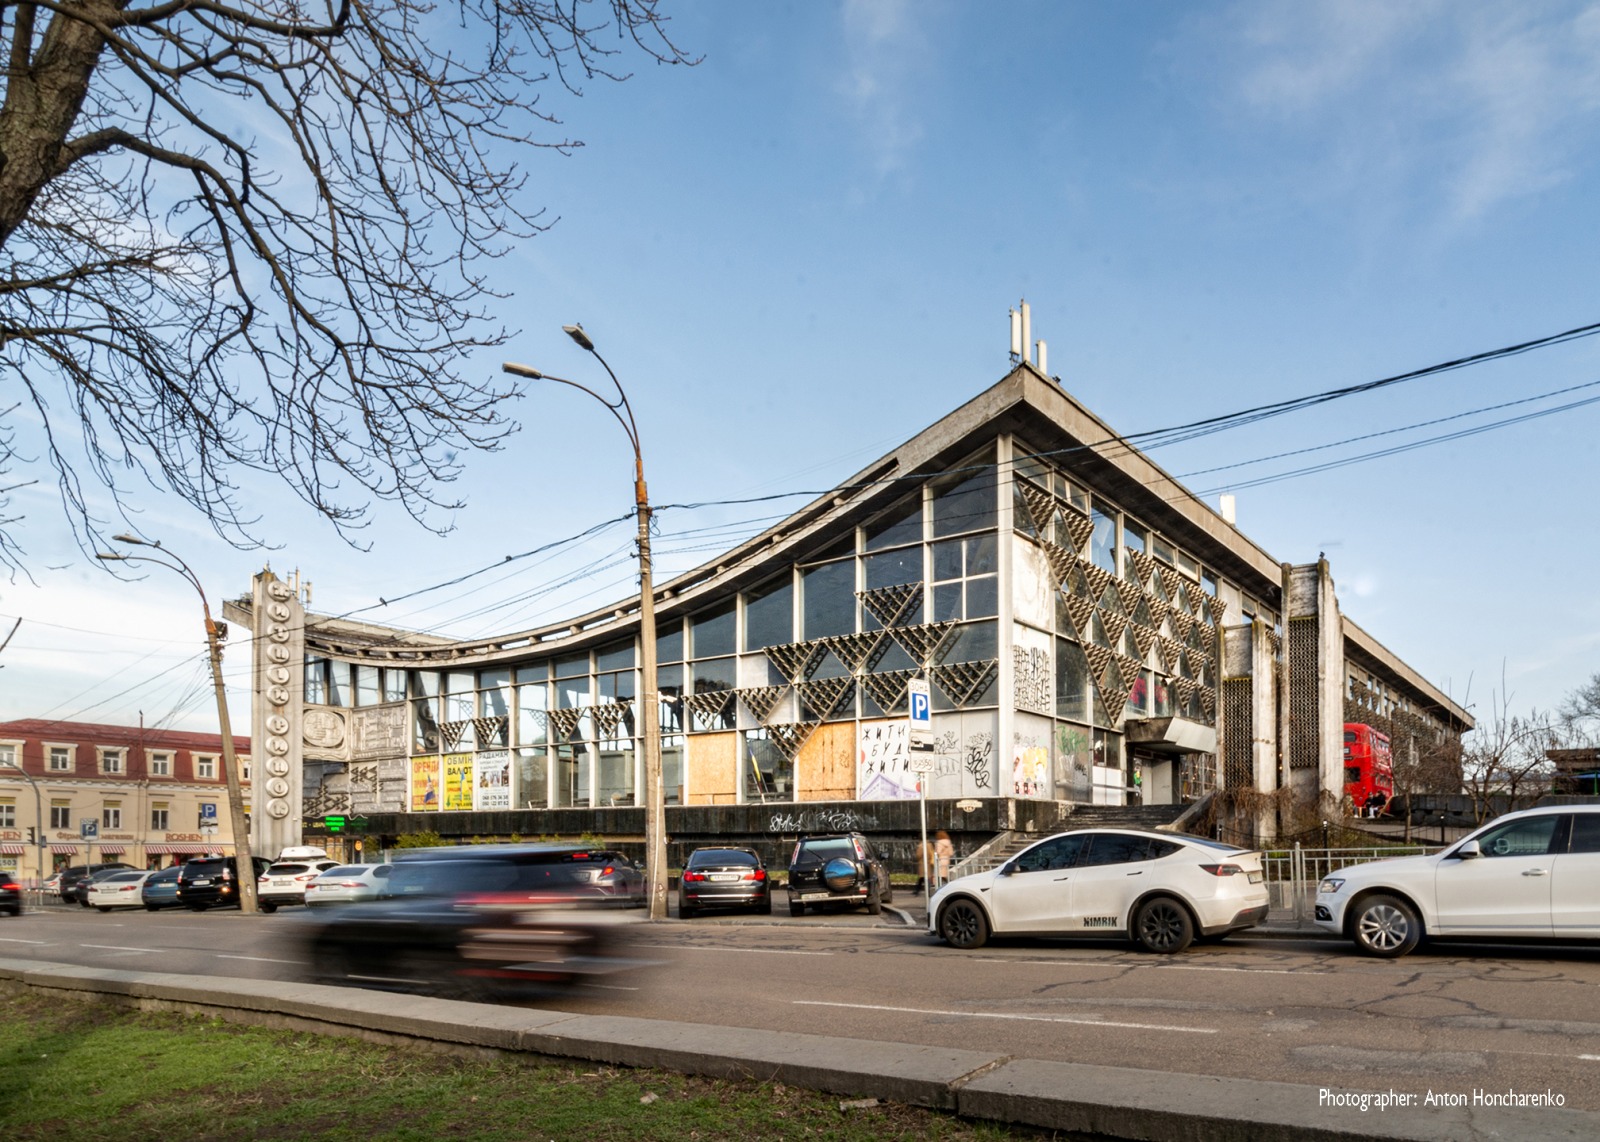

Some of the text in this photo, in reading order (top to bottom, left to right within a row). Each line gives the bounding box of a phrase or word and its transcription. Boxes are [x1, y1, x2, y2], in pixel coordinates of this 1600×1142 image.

[915, 694, 926, 719] P
[447, 755, 473, 766] ОБМІН
[165, 833, 203, 842] ROSHEN
